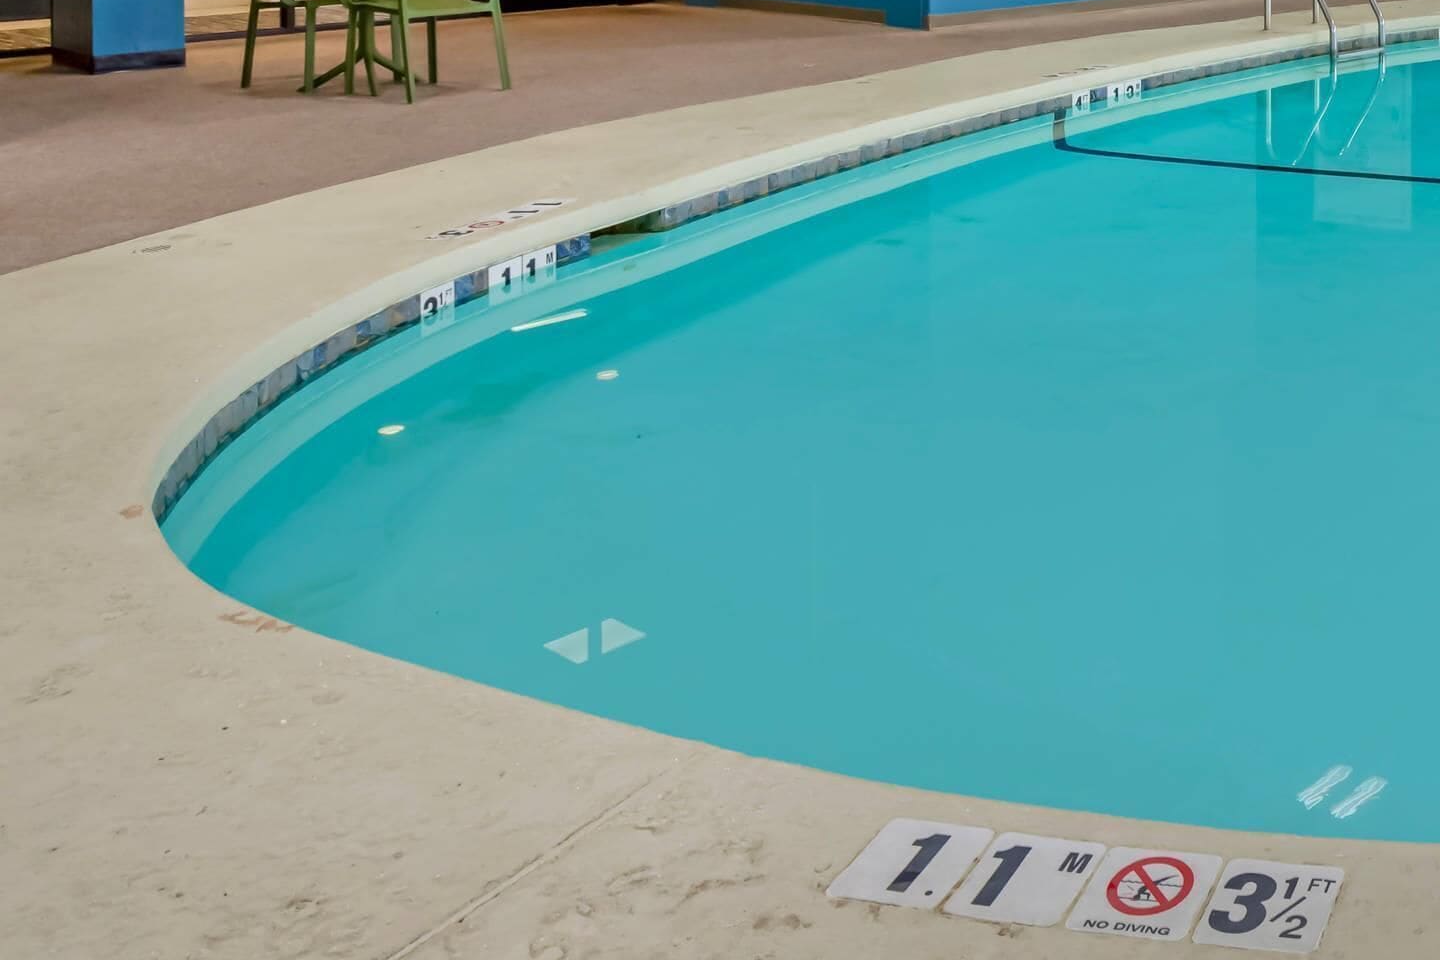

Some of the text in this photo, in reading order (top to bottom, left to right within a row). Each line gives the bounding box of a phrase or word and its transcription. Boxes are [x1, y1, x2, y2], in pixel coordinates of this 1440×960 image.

[1058, 852, 1093, 874] M
[1307, 878, 1336, 893] FT
[1083, 919, 1171, 935] NO DIVING
